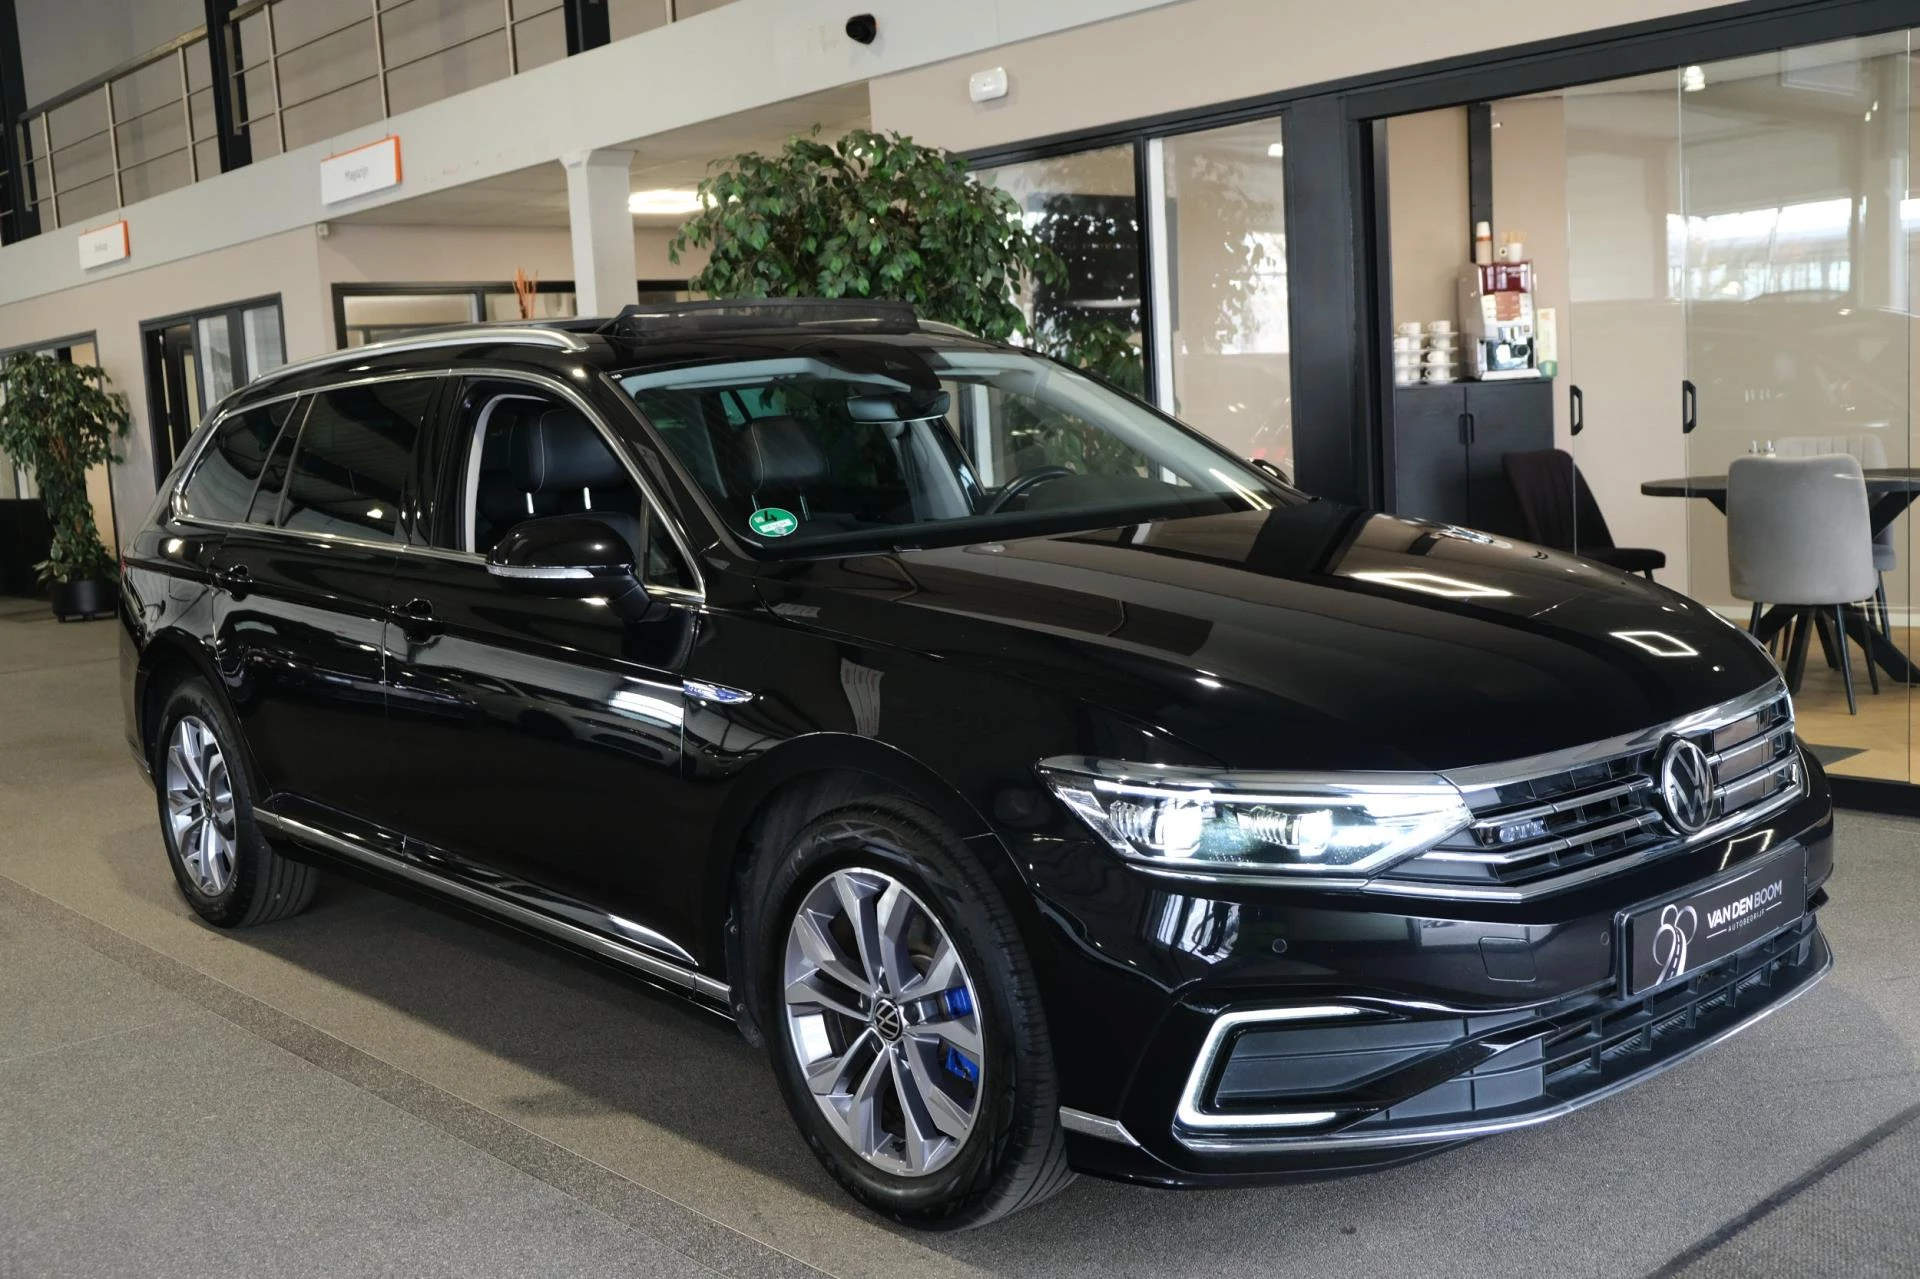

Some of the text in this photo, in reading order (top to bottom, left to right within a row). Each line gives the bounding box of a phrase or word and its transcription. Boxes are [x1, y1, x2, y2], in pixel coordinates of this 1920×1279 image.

[1499, 820, 1546, 843] GTE
[1707, 879, 1783, 929] VAN DEN BOOM
[1727, 908, 1765, 932] AUTOBEDRIJF
